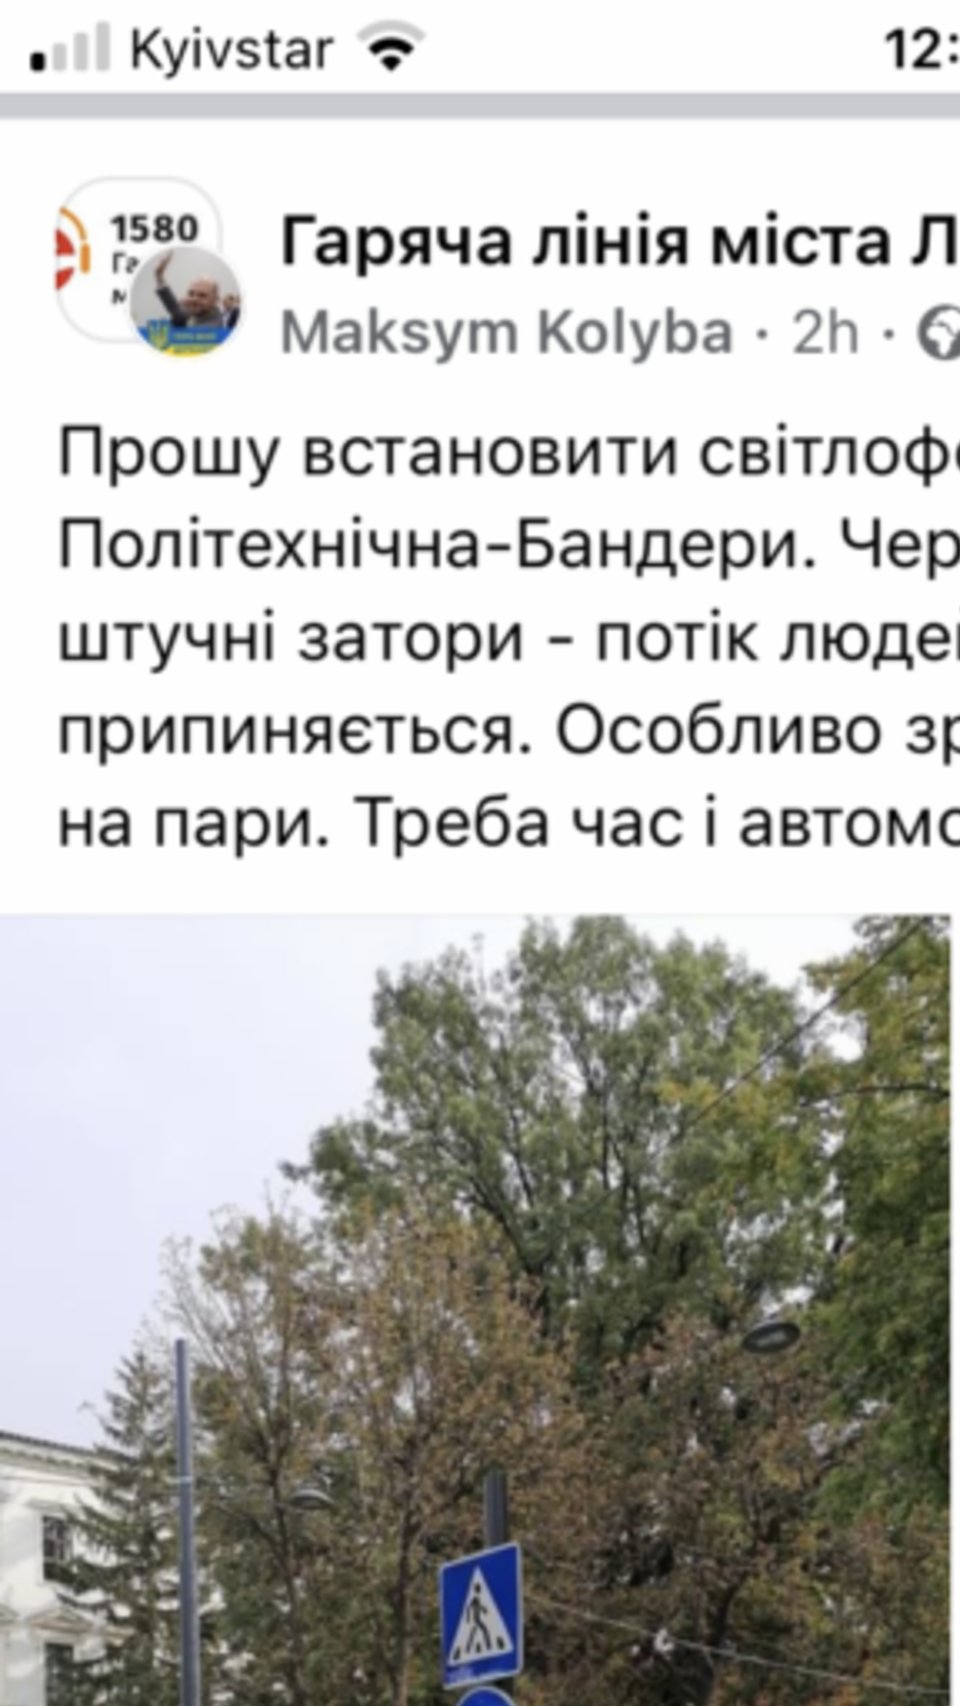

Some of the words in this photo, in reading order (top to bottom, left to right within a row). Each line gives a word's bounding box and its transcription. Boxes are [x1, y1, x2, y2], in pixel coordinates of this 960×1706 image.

[132, 26, 334, 79] Kyivstar
[110, 213, 199, 243] 1580
[283, 214, 511, 278] Гаряча
[532, 210, 688, 266] лінія
[712, 210, 890, 266] міста
[283, 307, 516, 364] Maksym
[540, 307, 731, 364] Kolyba
[795, 309, 857, 353] 2h
[61, 424, 280, 488] Прошу
[305, 436, 676, 476] встановити
[61, 515, 814, 580] Політехнічна-Бандери.
[60, 608, 273, 674] штучні
[299, 622, 521, 673] затори
[598, 608, 758, 662] потік
[60, 715, 530, 766] припиняється.
[557, 700, 881, 755] Особливо
[60, 807, 131, 847] на
[156, 807, 328, 859] пари.
[353, 793, 548, 859] Треба
[573, 807, 683, 847] час
[706, 793, 715, 847] і
